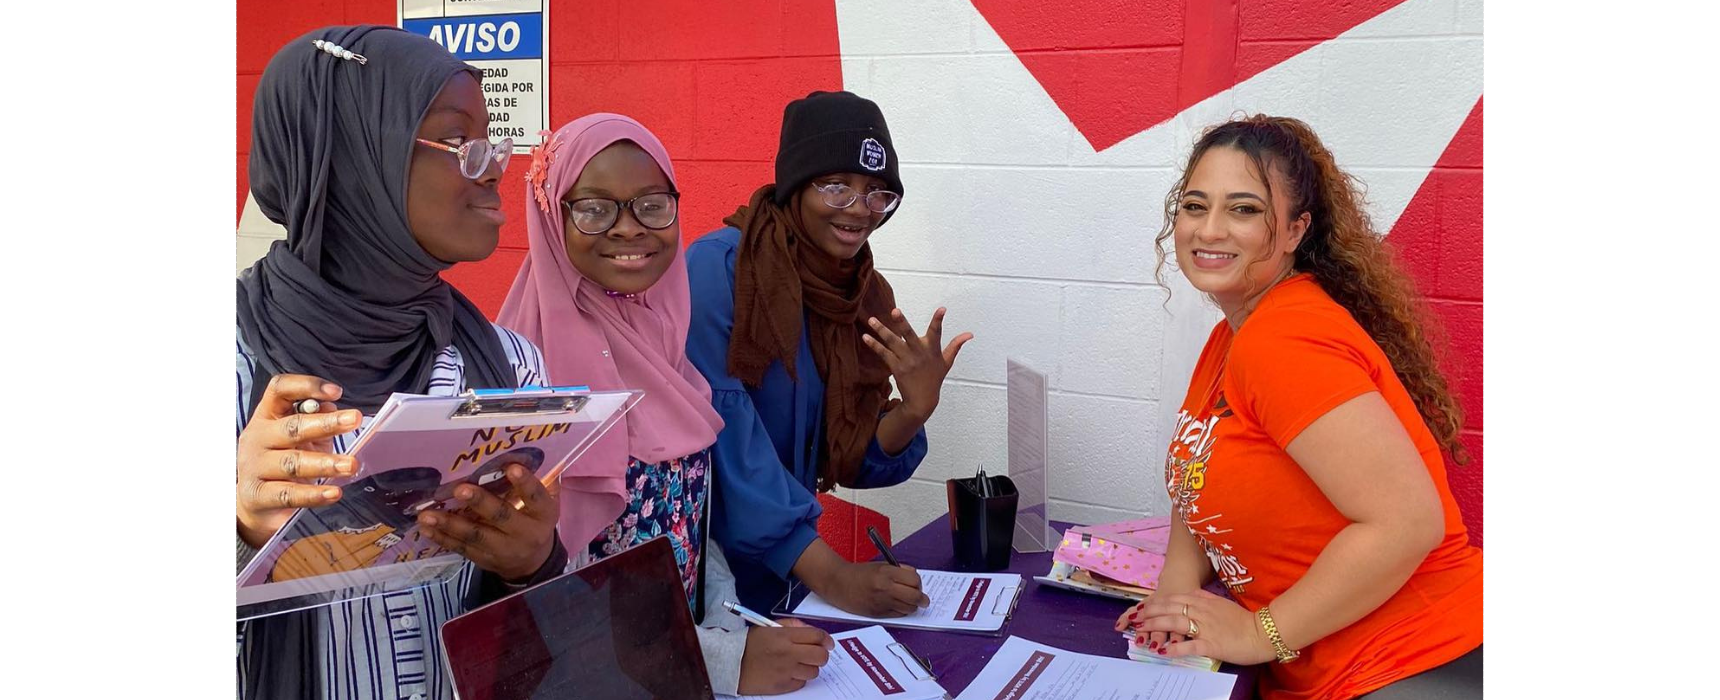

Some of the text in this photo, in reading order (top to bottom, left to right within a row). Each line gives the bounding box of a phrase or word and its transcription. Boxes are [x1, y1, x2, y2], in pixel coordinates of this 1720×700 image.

[429, 21, 521, 53] AVISO
[512, 82, 534, 93] POR
[503, 97, 518, 108] DE
[488, 127, 525, 137] HORAS
[451, 422, 572, 471] MUSLIM
